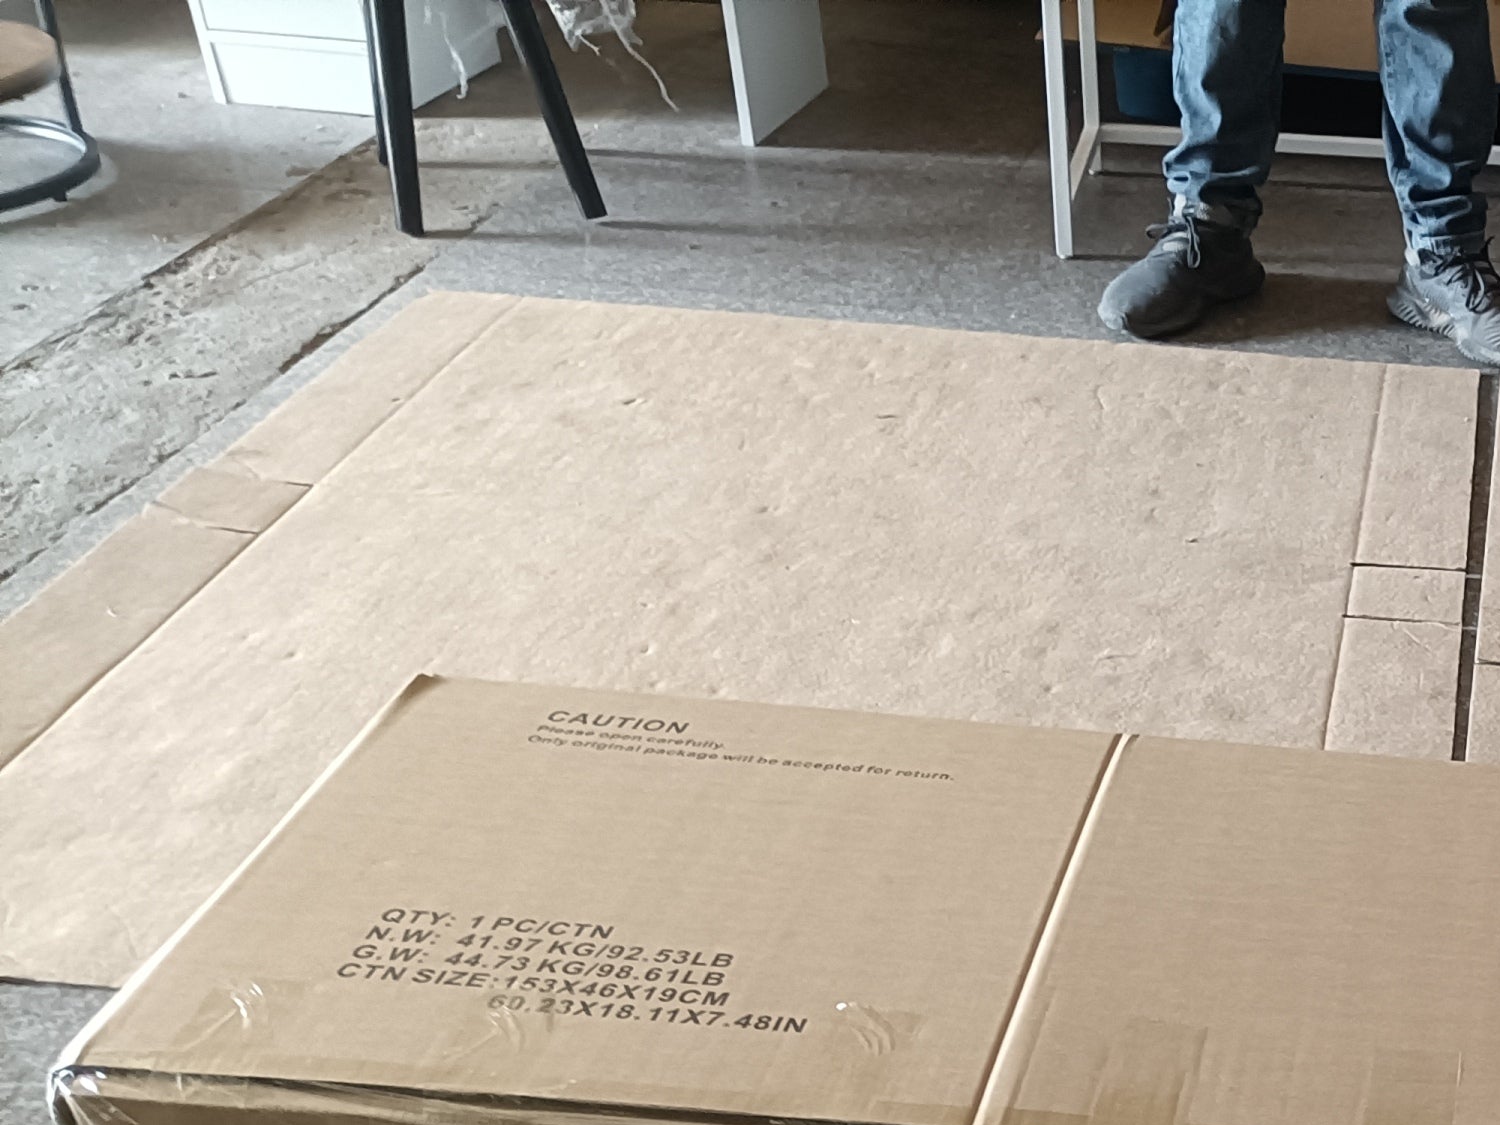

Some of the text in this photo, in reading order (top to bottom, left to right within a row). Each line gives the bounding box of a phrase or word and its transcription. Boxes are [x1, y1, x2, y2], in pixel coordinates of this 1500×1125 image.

[537, 725, 724, 750] Please open carefully.
[547, 710, 689, 734] CAUTION
[528, 734, 954, 781] Only original package will be accepted for return.
[381, 908, 615, 939] QTY: 1 PC/CTN
[365, 925, 734, 968] N.W: 41.97 KG/92.53LB
[337, 962, 407, 981] CTN
[352, 944, 726, 986] G.W: 44.73 KG/98.61LB
[487, 994, 808, 1033] 60.23X18.11X7.48IN
